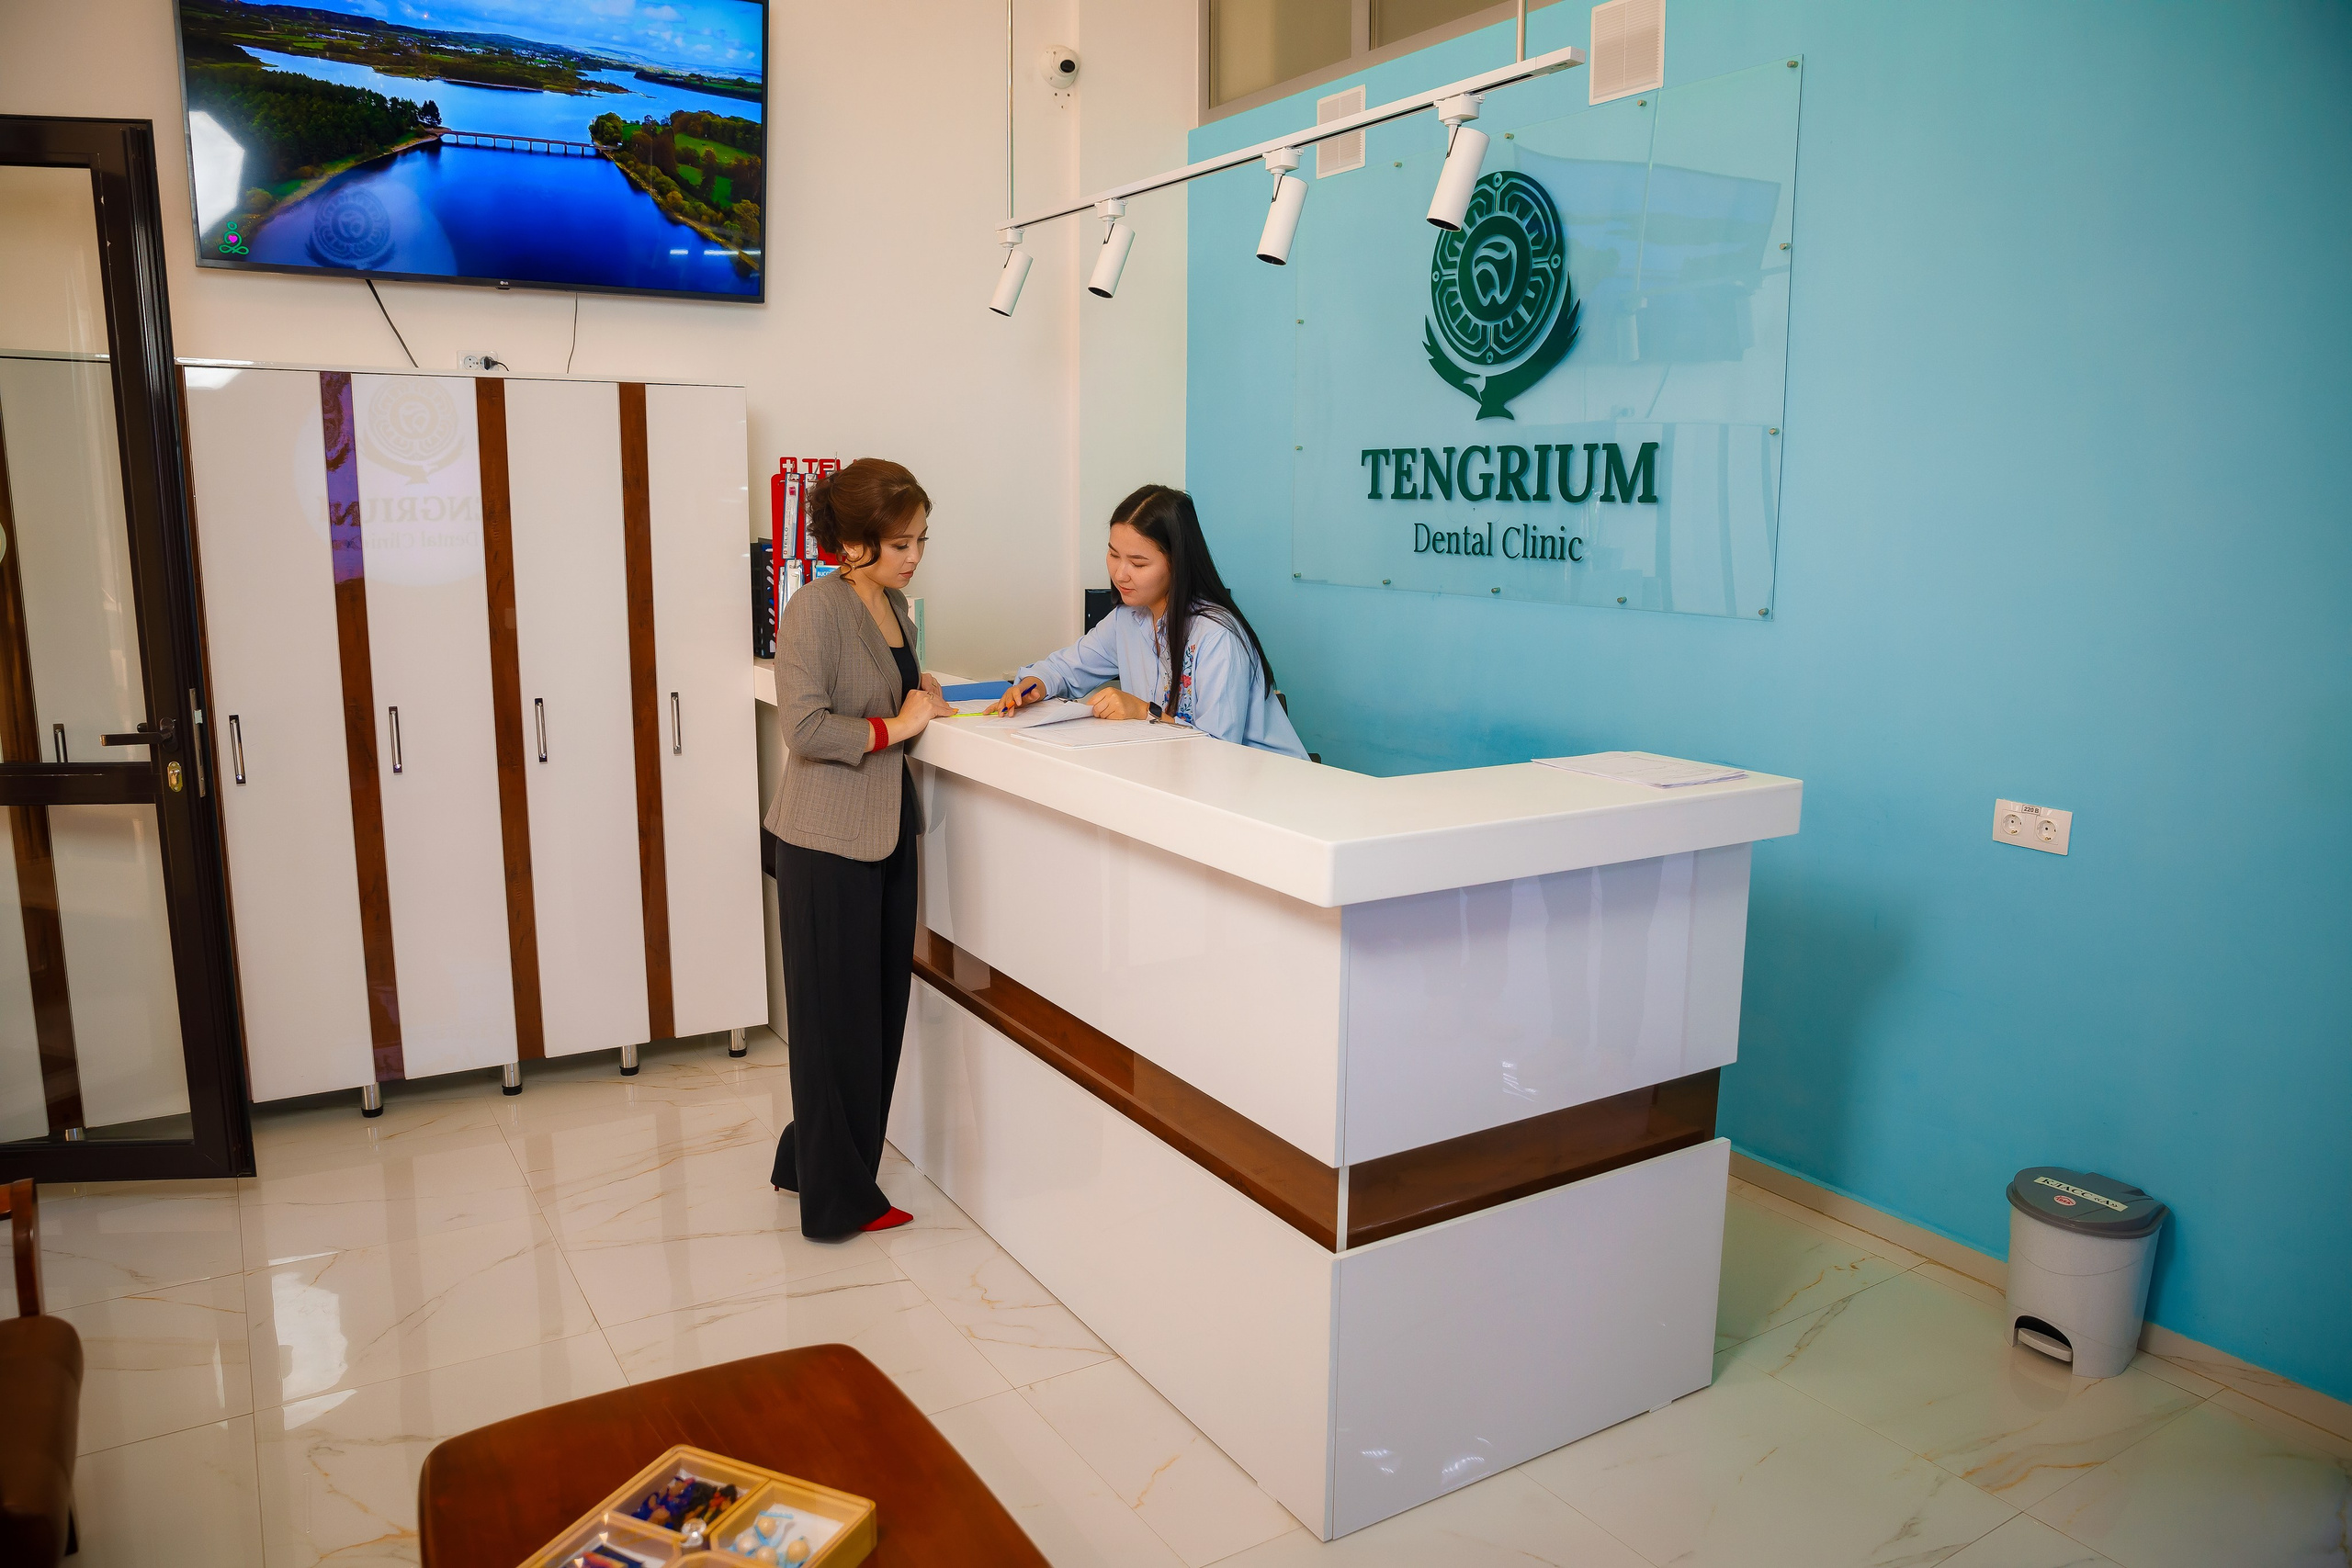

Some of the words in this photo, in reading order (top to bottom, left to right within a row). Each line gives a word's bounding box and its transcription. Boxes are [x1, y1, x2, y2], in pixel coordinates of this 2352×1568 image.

[1361, 442, 1659, 504] TENGRIUM
[1413, 522, 1493, 557] Dental
[1502, 524, 1583, 562] Clinic
[2041, 1179, 2093, 1198] КЛАСС
